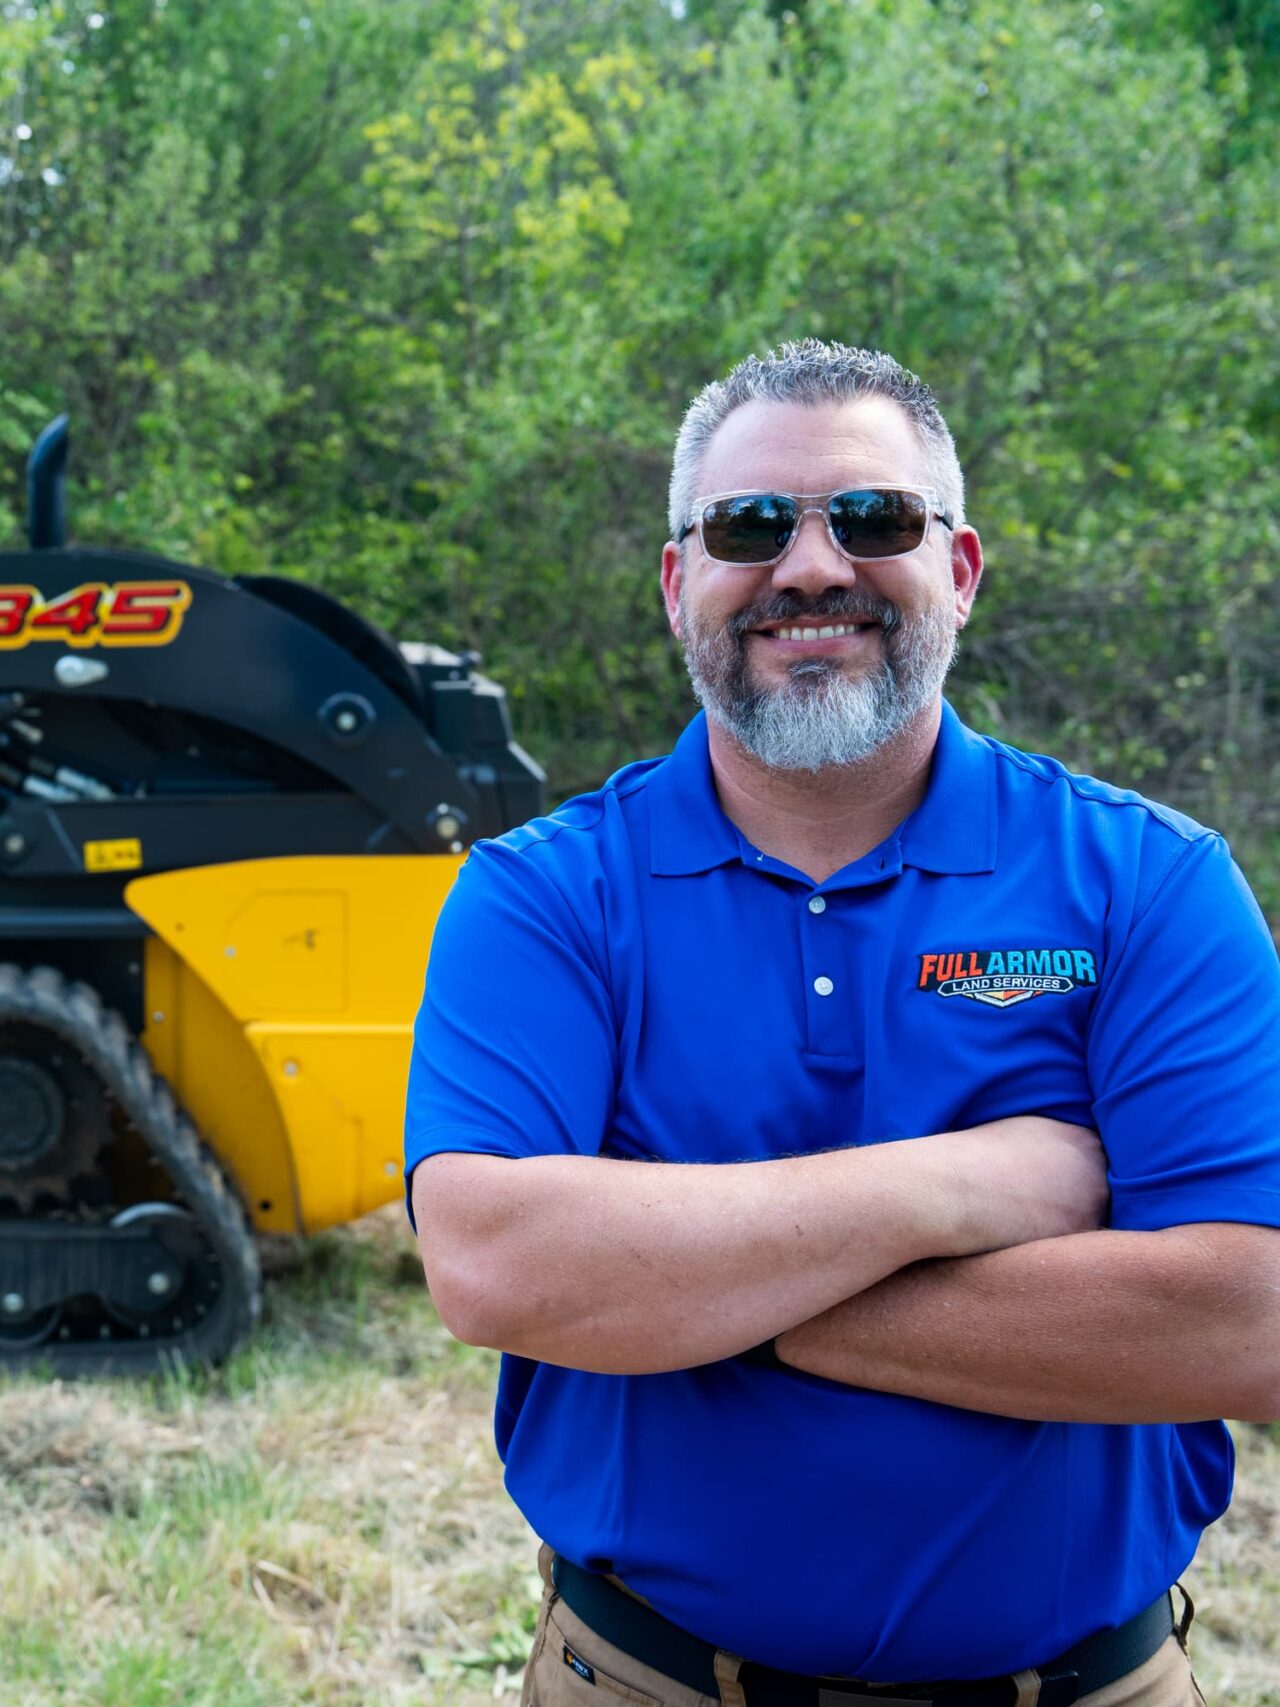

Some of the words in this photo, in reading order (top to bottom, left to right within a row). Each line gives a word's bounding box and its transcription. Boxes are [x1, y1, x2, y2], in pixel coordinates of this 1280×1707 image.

[919, 952, 983, 987] FULL
[986, 949, 1097, 984] ARMOR
[952, 978, 990, 992] LAND
[993, 976, 1061, 989] SERVICES
